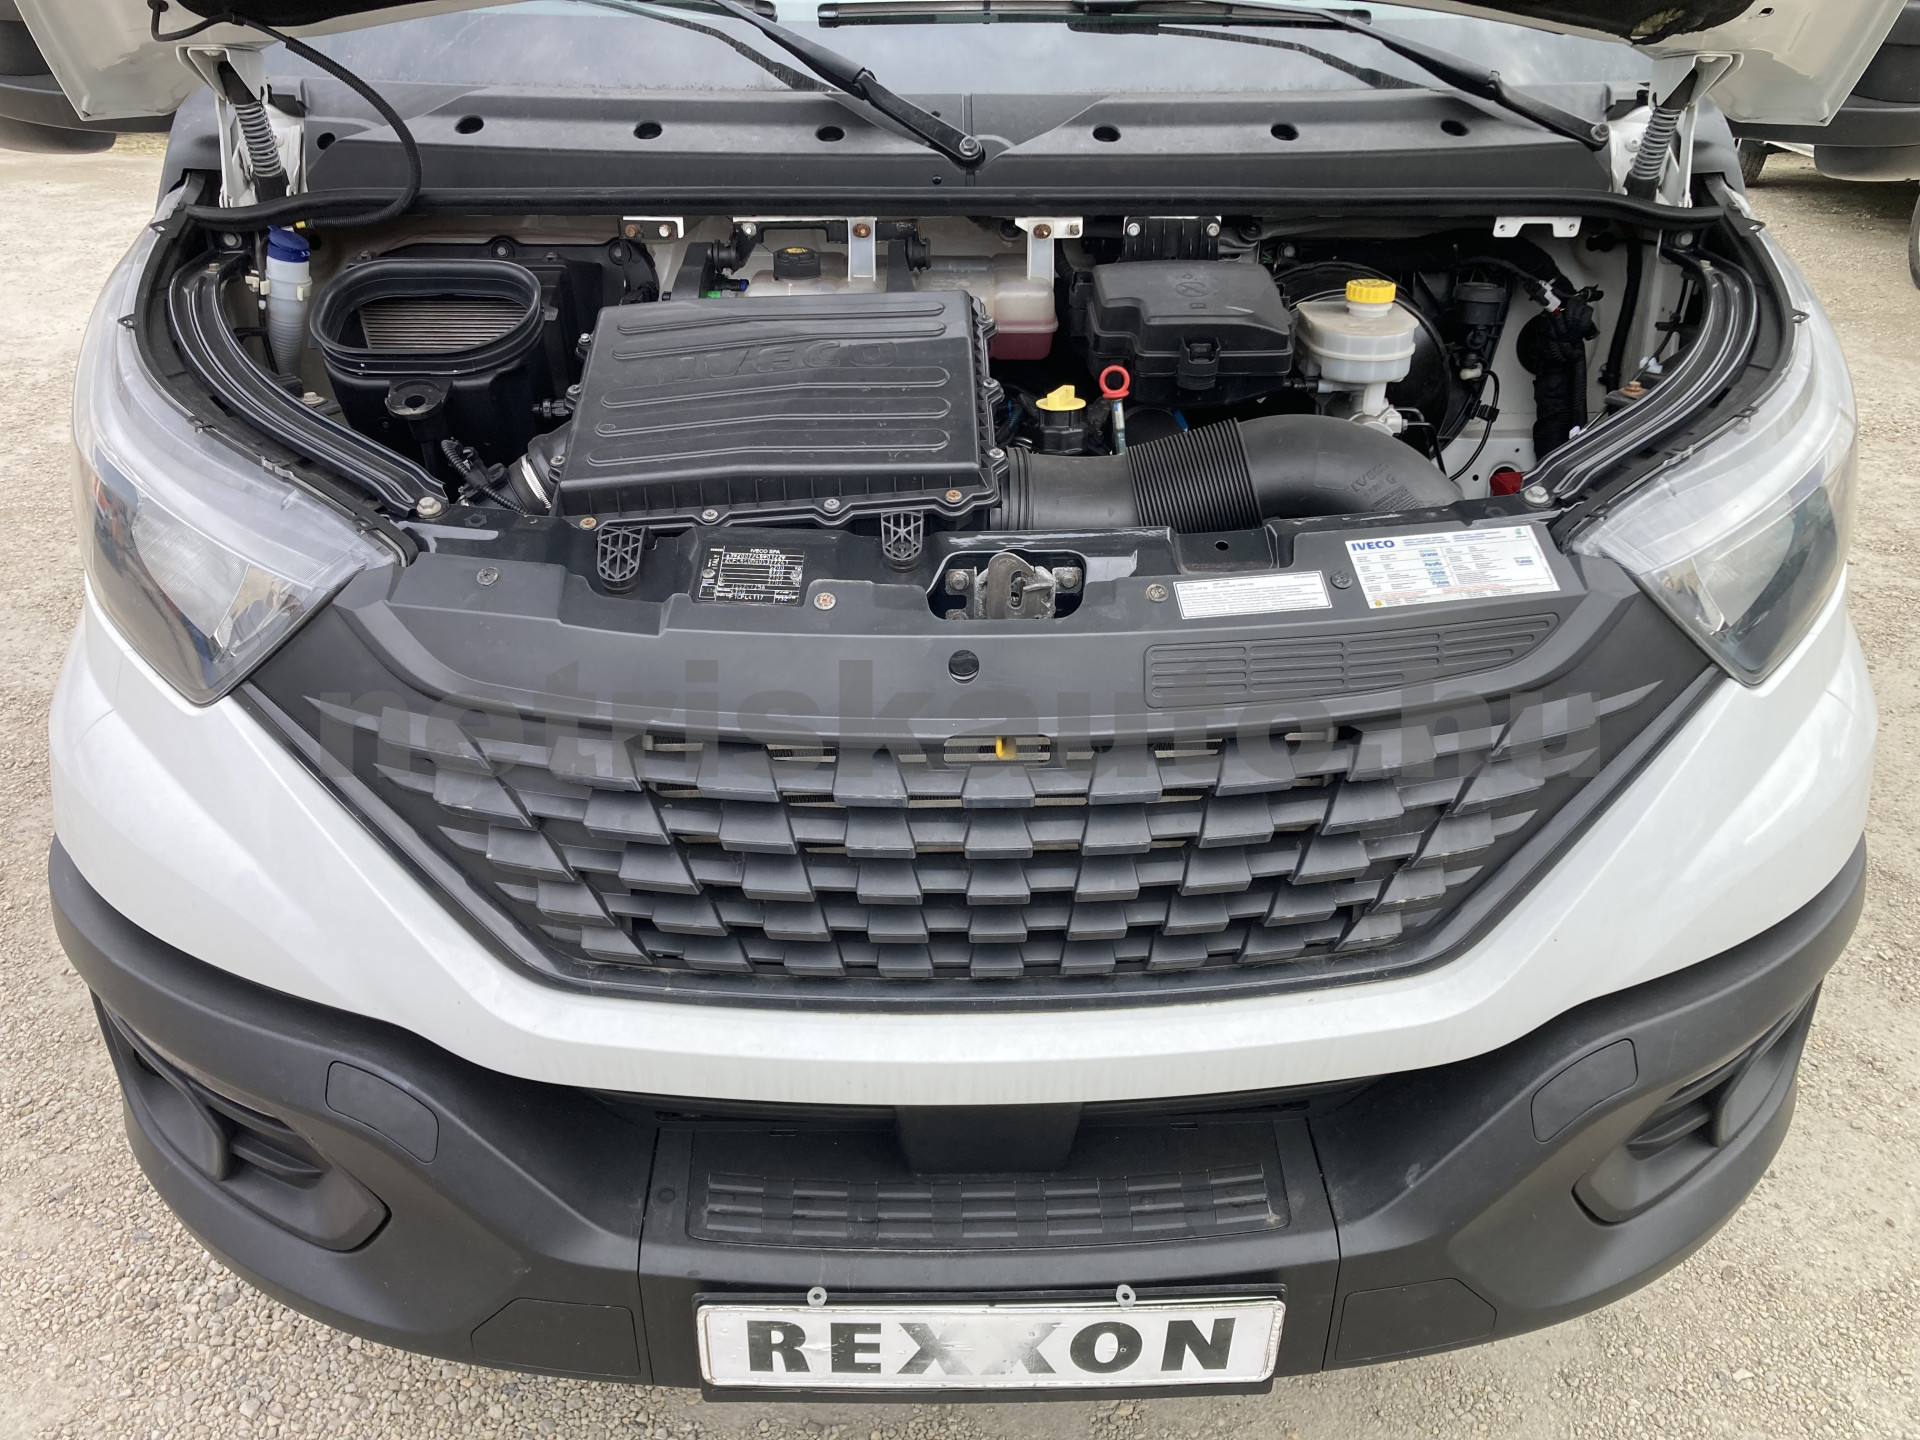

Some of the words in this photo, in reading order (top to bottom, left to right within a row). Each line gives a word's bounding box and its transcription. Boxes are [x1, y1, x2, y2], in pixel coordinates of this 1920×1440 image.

[673, 341, 899, 382] IVECO
[1350, 460, 1390, 492] IVE
[1351, 539, 1395, 551] IVECO
[746, 1317, 1236, 1375] REXXON
